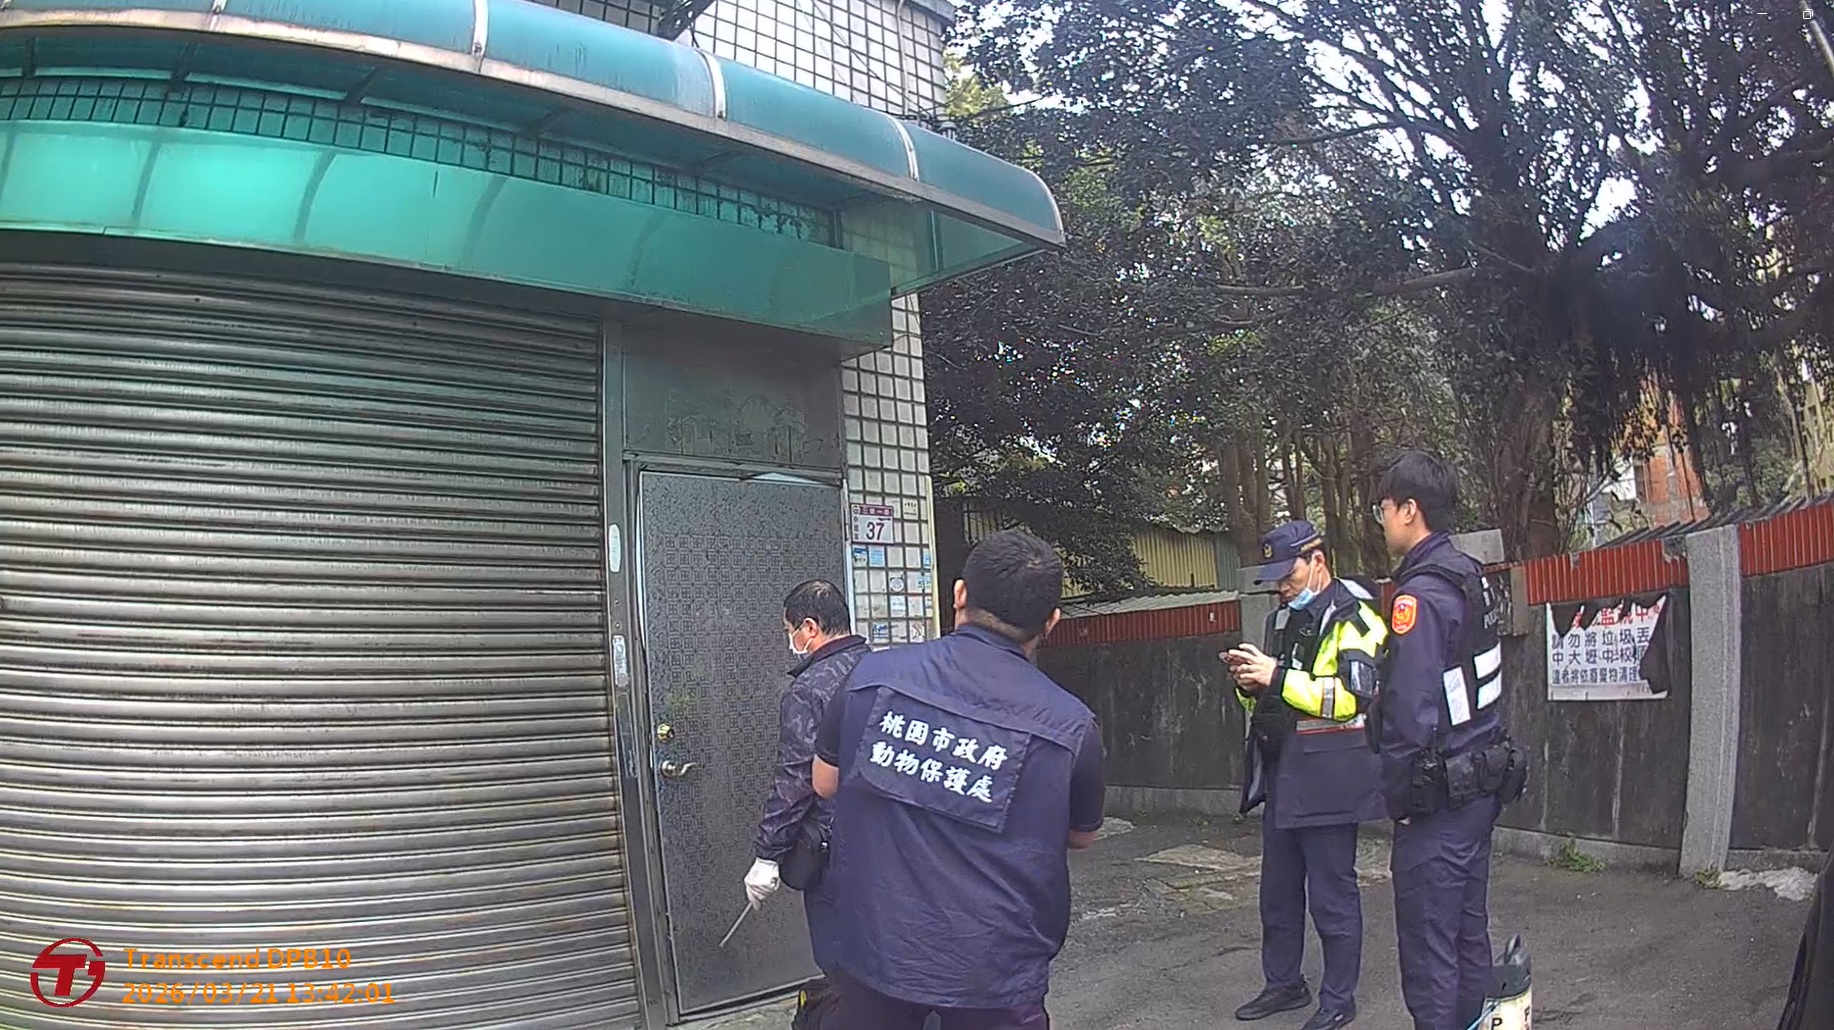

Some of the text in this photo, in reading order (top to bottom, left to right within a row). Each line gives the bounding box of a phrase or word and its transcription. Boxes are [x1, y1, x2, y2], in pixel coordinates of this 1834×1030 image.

[866, 521, 885, 541] 37
[879, 711, 1008, 771] 桃園市政府
[869, 741, 993, 803] 動物保護處
